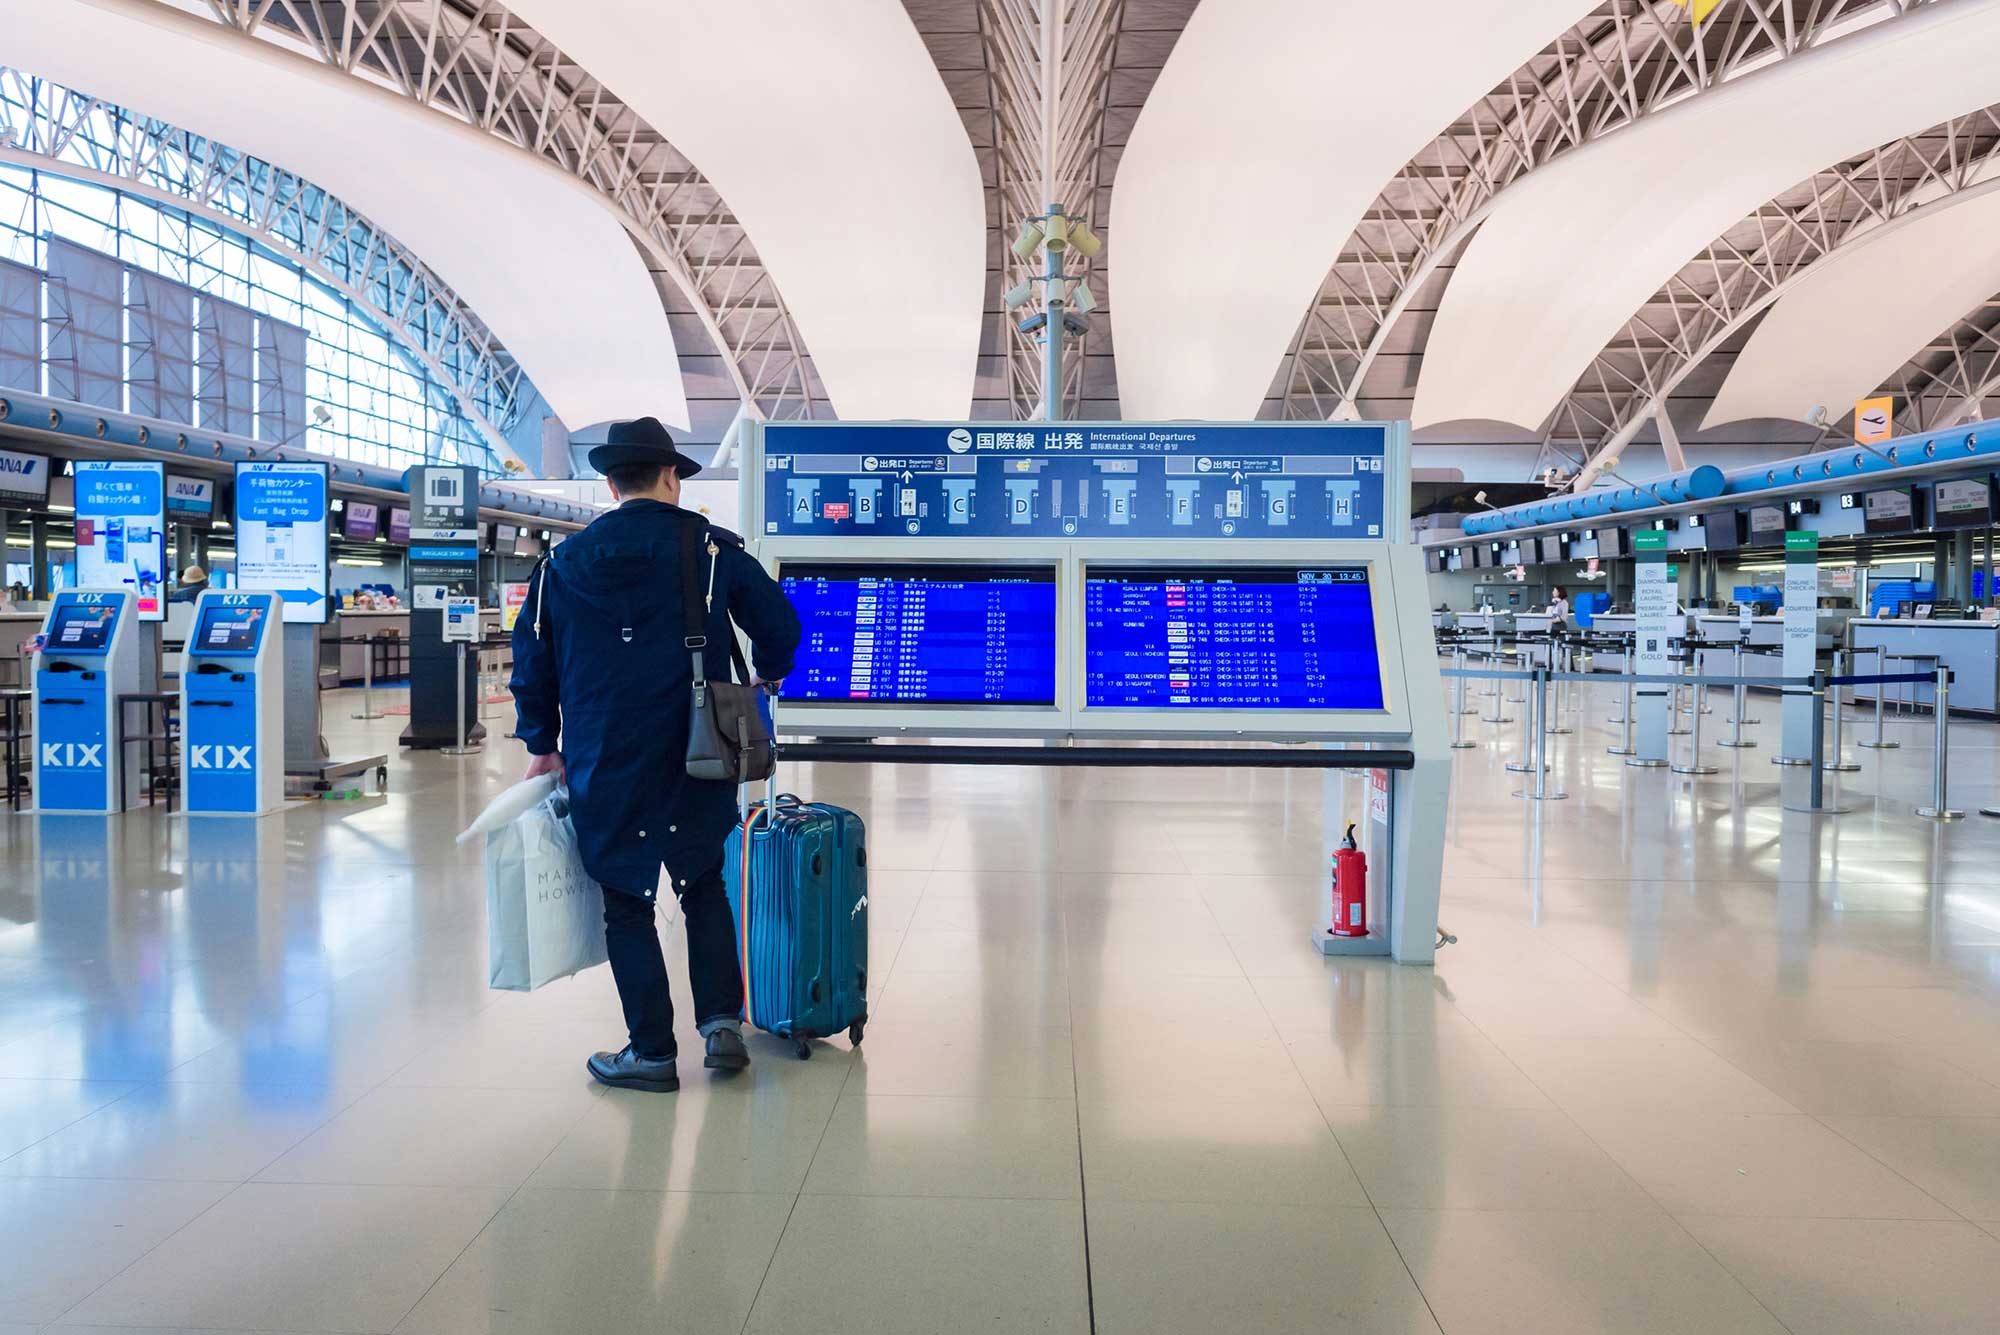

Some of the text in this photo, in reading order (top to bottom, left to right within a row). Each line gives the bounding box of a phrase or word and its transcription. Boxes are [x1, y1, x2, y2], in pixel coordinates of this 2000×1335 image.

[976, 432, 1083, 450] 国際線 出発
[1090, 433, 1196, 443] International Departures
[879, 459, 907, 468] 出発口
[1212, 460, 1241, 469] 出発口
[175, 483, 195, 496] ANA
[796, 499, 810, 513] A
[860, 499, 871, 513] B
[953, 499, 965, 513] C
[1015, 499, 1027, 513] D
[1114, 499, 1126, 514] E
[1178, 499, 1189, 514] F
[1271, 499, 1284, 514] G
[1336, 499, 1349, 514] H
[1790, 501, 1802, 514] B4
[1841, 494, 1853, 508] B3
[253, 507, 309, 516] Fast Bag Drop
[1301, 573, 1315, 581] NOV
[76, 593, 104, 604] KIX
[222, 594, 250, 605] KIX
[42, 743, 103, 767] KIX
[190, 745, 252, 769] KIX
